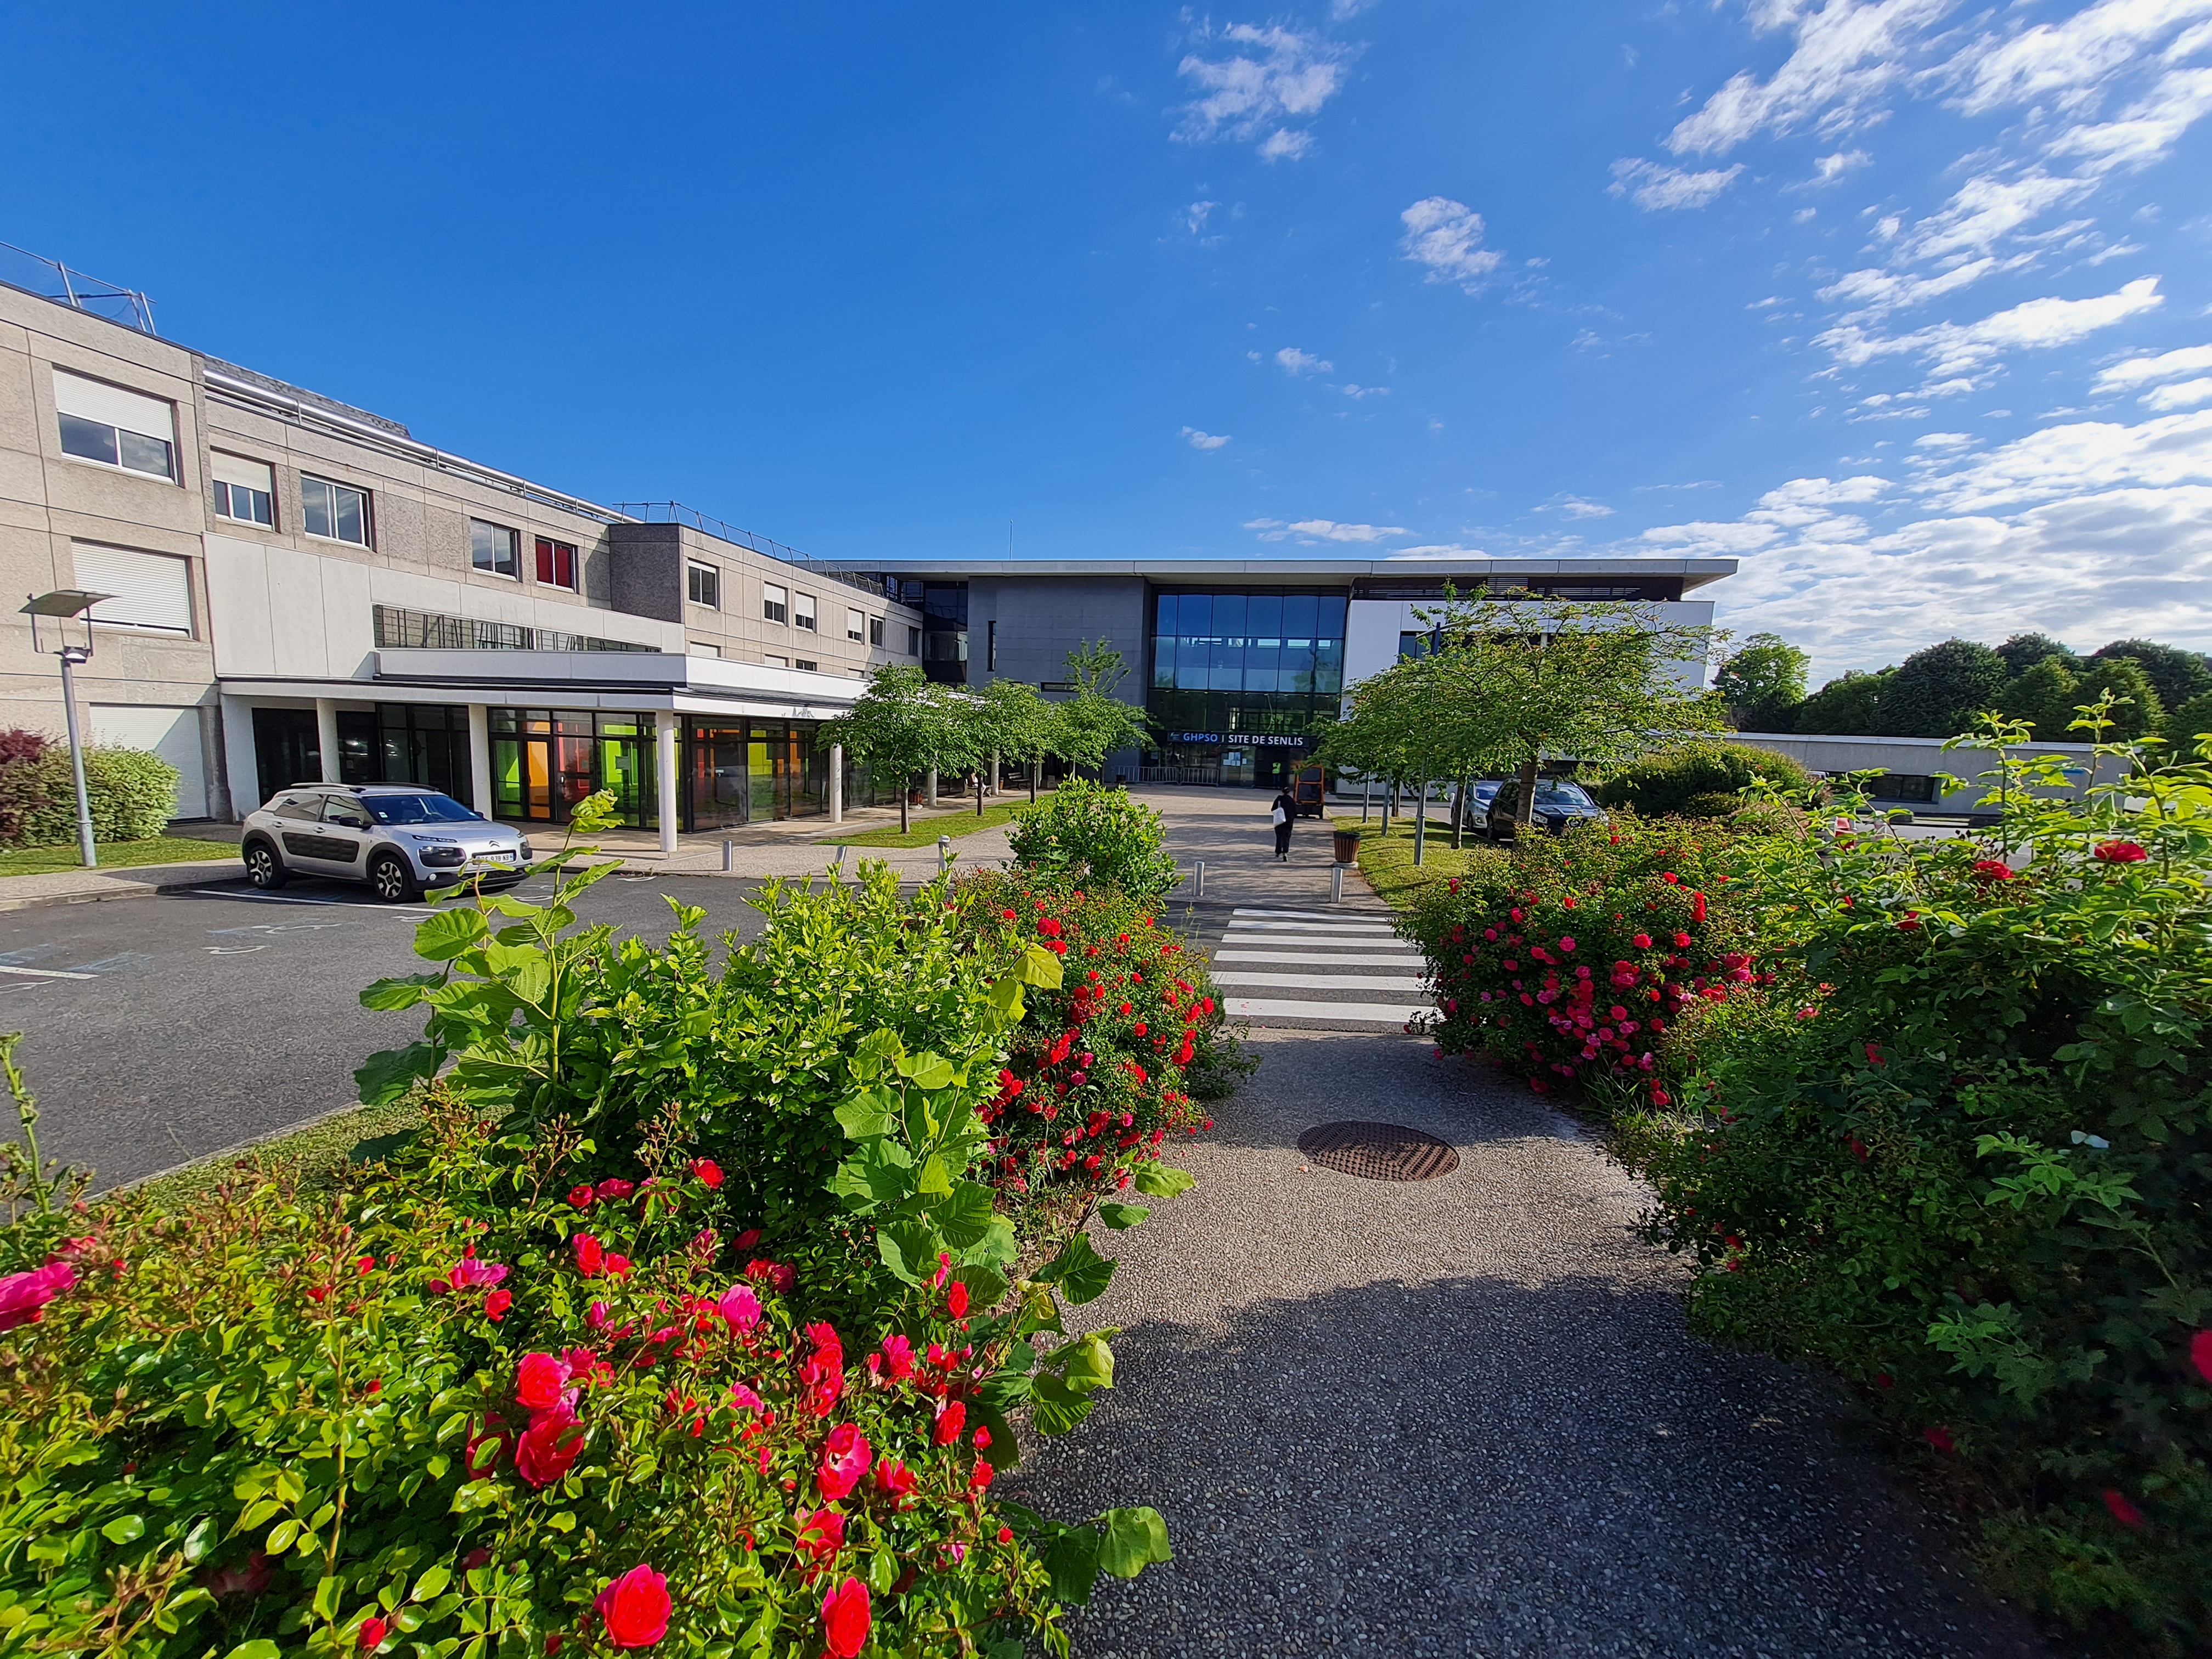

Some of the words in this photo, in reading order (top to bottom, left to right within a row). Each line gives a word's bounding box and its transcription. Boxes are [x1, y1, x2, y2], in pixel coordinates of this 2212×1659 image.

[1183, 733, 1218, 742] GHPSO
[1228, 735, 1249, 743] SITE
[1252, 736, 1266, 744] DE
[1267, 736, 1304, 746] SENLIS
